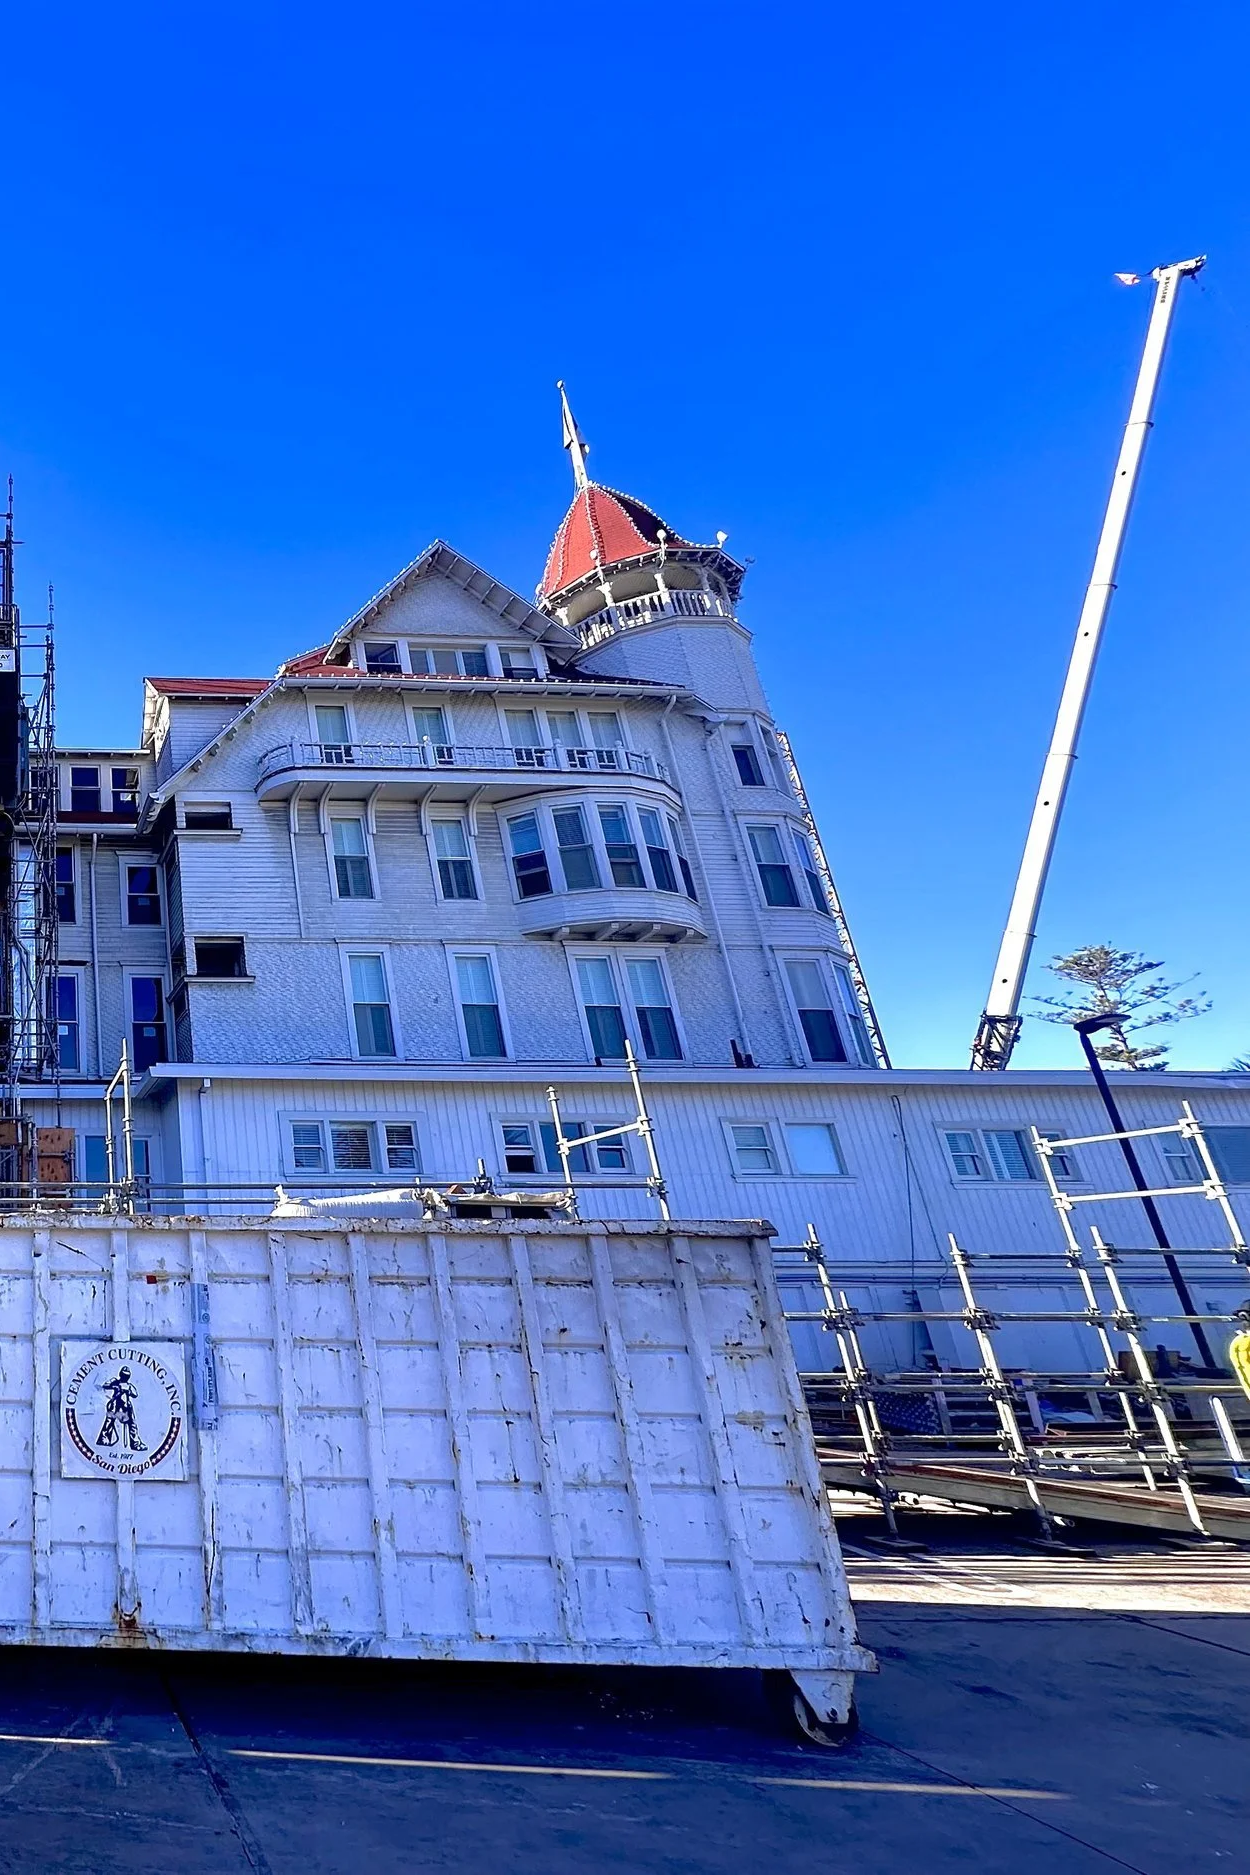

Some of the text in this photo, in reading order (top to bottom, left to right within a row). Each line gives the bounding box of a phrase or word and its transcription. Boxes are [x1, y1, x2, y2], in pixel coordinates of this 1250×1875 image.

[66, 1348, 181, 1416] CEMENT CUTTING, INC.
[92, 1454, 150, 1475] San Diego
